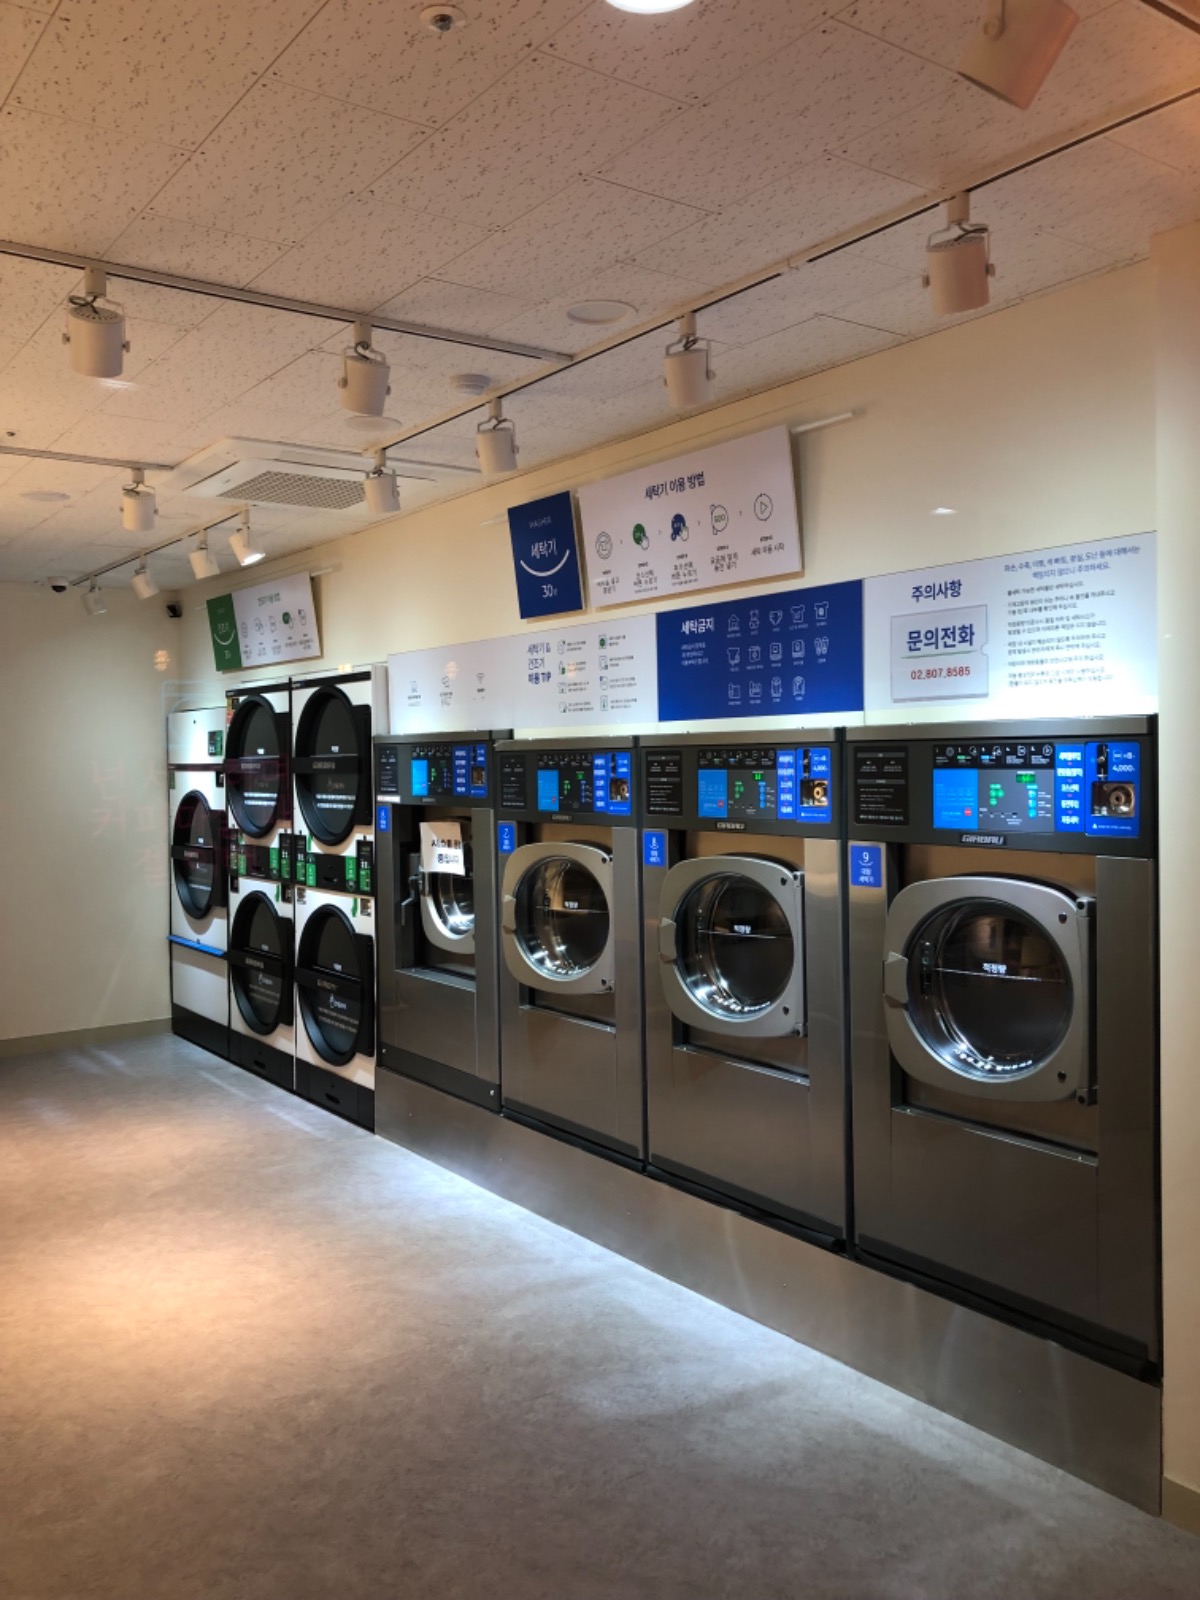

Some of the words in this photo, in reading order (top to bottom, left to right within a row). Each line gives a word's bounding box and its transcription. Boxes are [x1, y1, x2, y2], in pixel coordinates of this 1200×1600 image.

[644, 481, 669, 500] 세탁기
[670, 477, 686, 493] 이용
[687, 470, 705, 489] 방법
[531, 538, 558, 559] 세탁기
[911, 579, 963, 603] 주의사항
[681, 617, 714, 635] 세탁금지
[906, 624, 975, 652] 문의전화
[910, 665, 971, 680] 02.807.8585
[862, 852, 869, 863] 9
